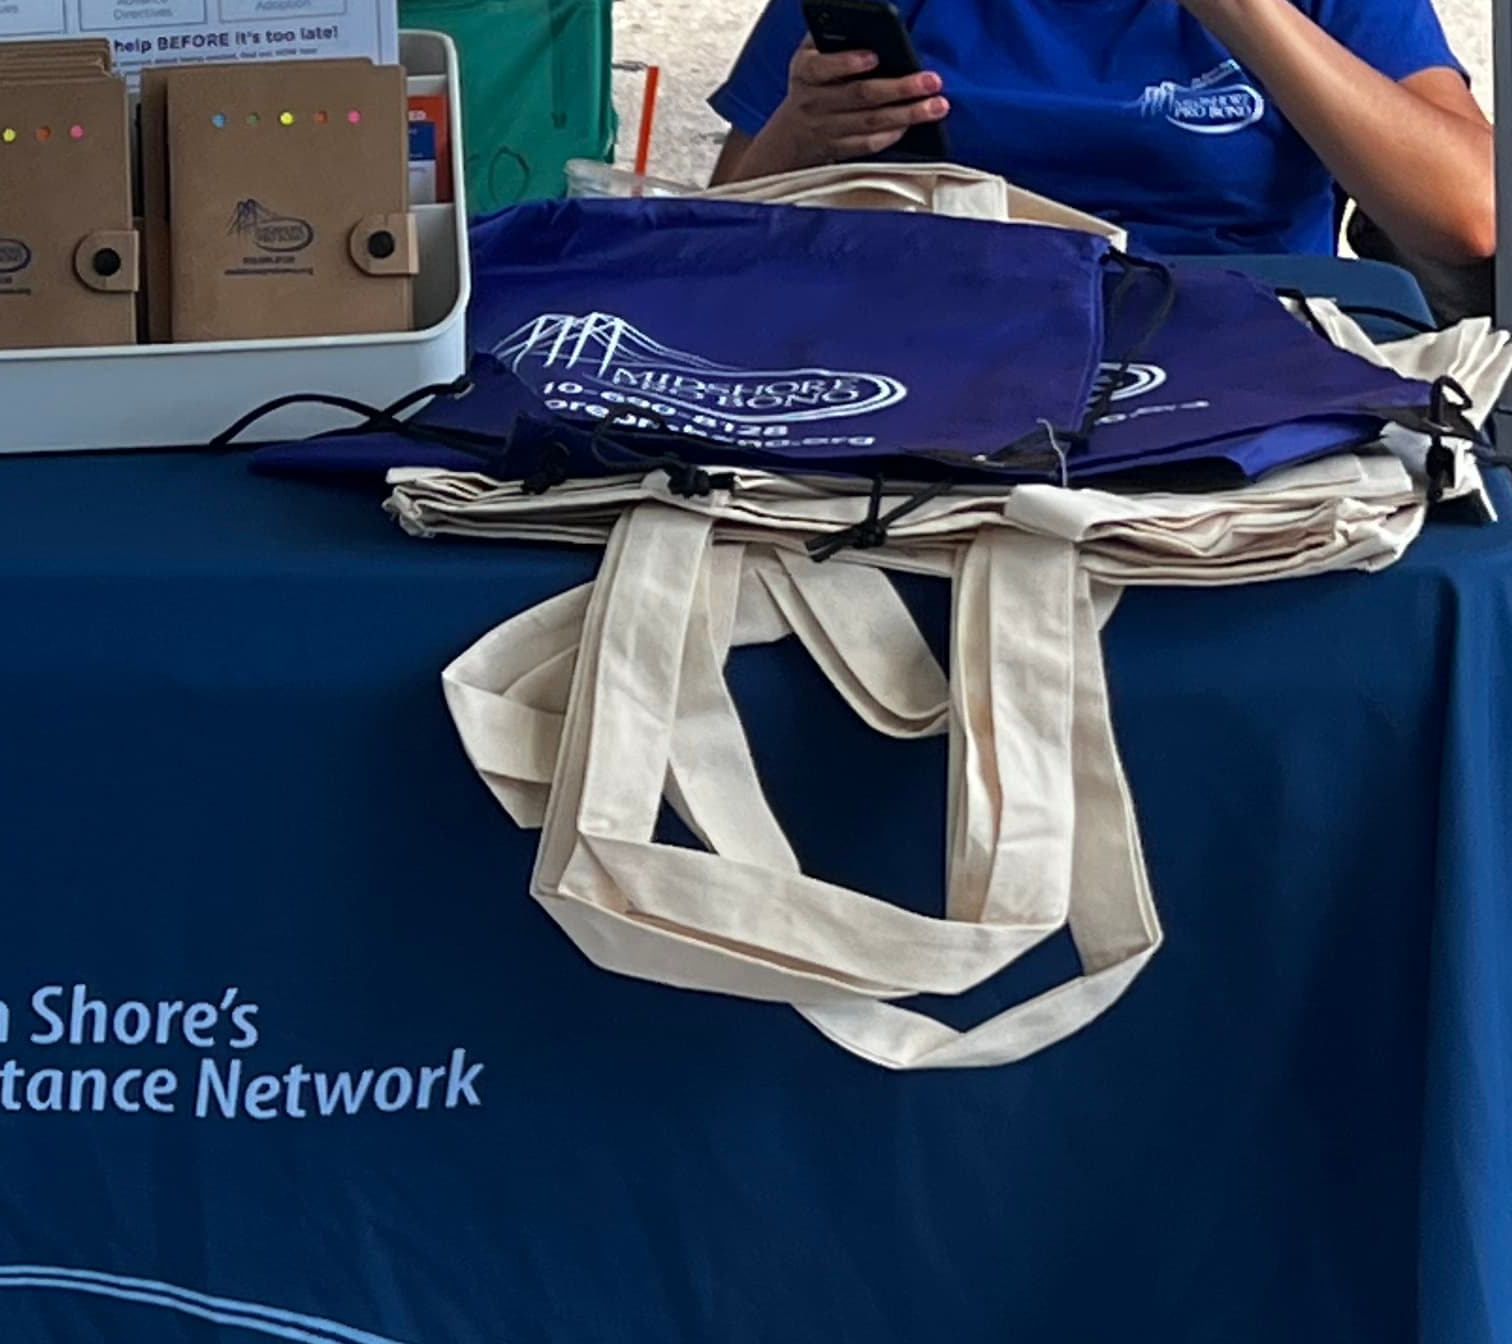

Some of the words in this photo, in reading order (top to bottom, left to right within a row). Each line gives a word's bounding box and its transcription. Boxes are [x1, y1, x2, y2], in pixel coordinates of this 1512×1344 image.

[114, 37, 152, 54] help
[157, 32, 229, 52] BEFORE
[265, 28, 296, 43] too
[543, 380, 789, 437] 10-690-8128
[194, 1047, 485, 1120] Network
